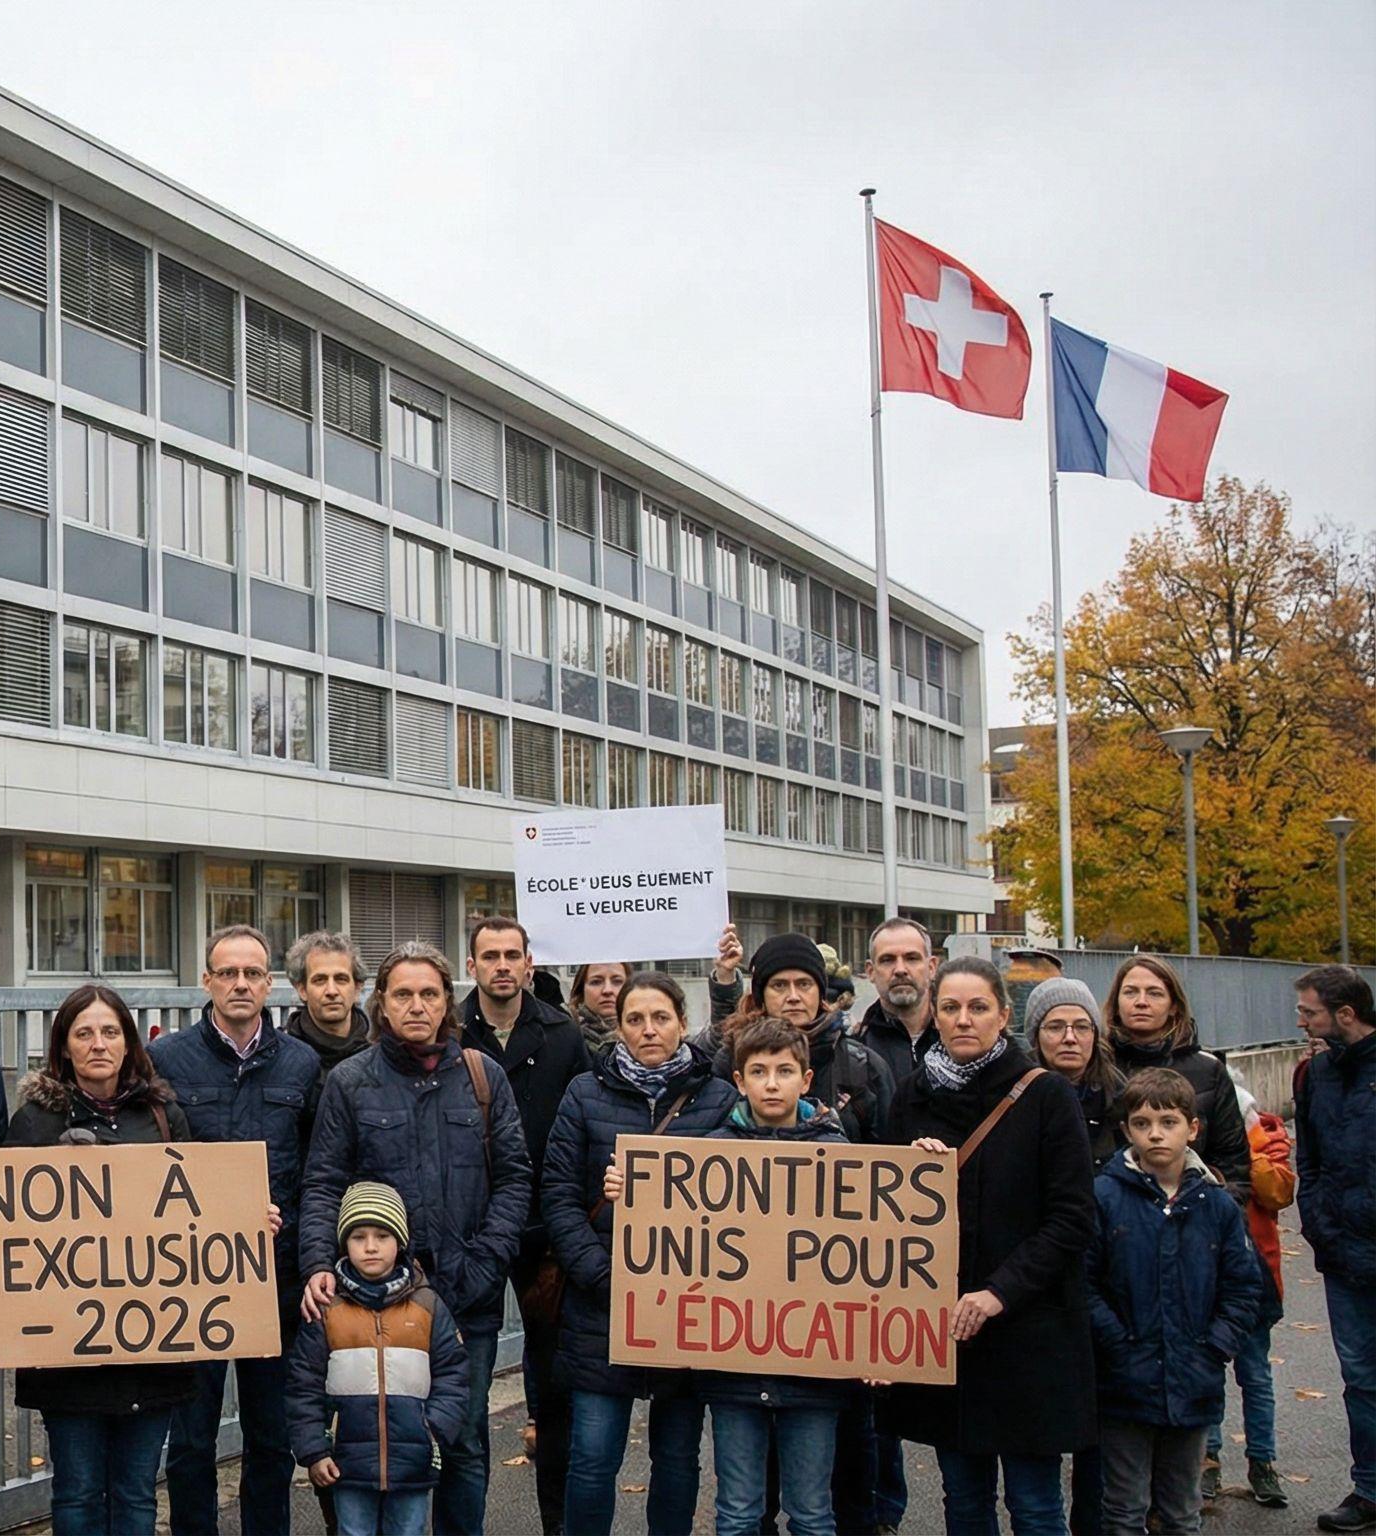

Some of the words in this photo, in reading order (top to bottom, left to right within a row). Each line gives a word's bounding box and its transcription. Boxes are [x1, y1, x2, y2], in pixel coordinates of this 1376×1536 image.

[566, 902, 586, 916] LE
[590, 897, 678, 914] VEUREURE
[154, 1146, 202, 1218] À
[787, 1229, 939, 1290] POUR
[73, 1294, 236, 1355] 2026
